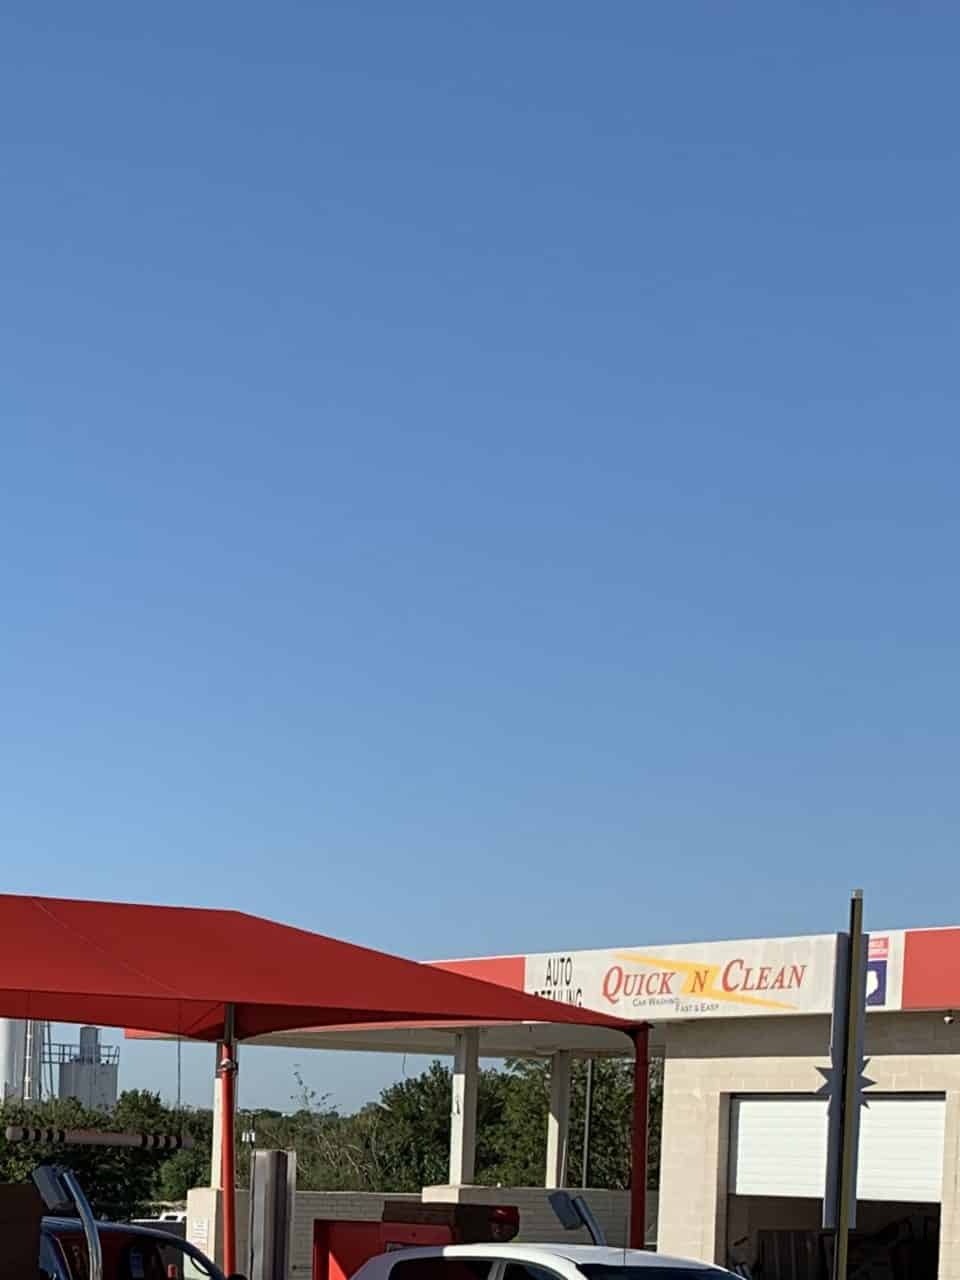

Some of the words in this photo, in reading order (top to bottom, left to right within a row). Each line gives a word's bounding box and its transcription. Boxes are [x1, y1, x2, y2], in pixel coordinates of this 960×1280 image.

[545, 957, 572, 987] AUTO
[602, 966, 676, 1004] QUICK
[690, 969, 709, 992] N
[722, 959, 808, 992] CLEAN
